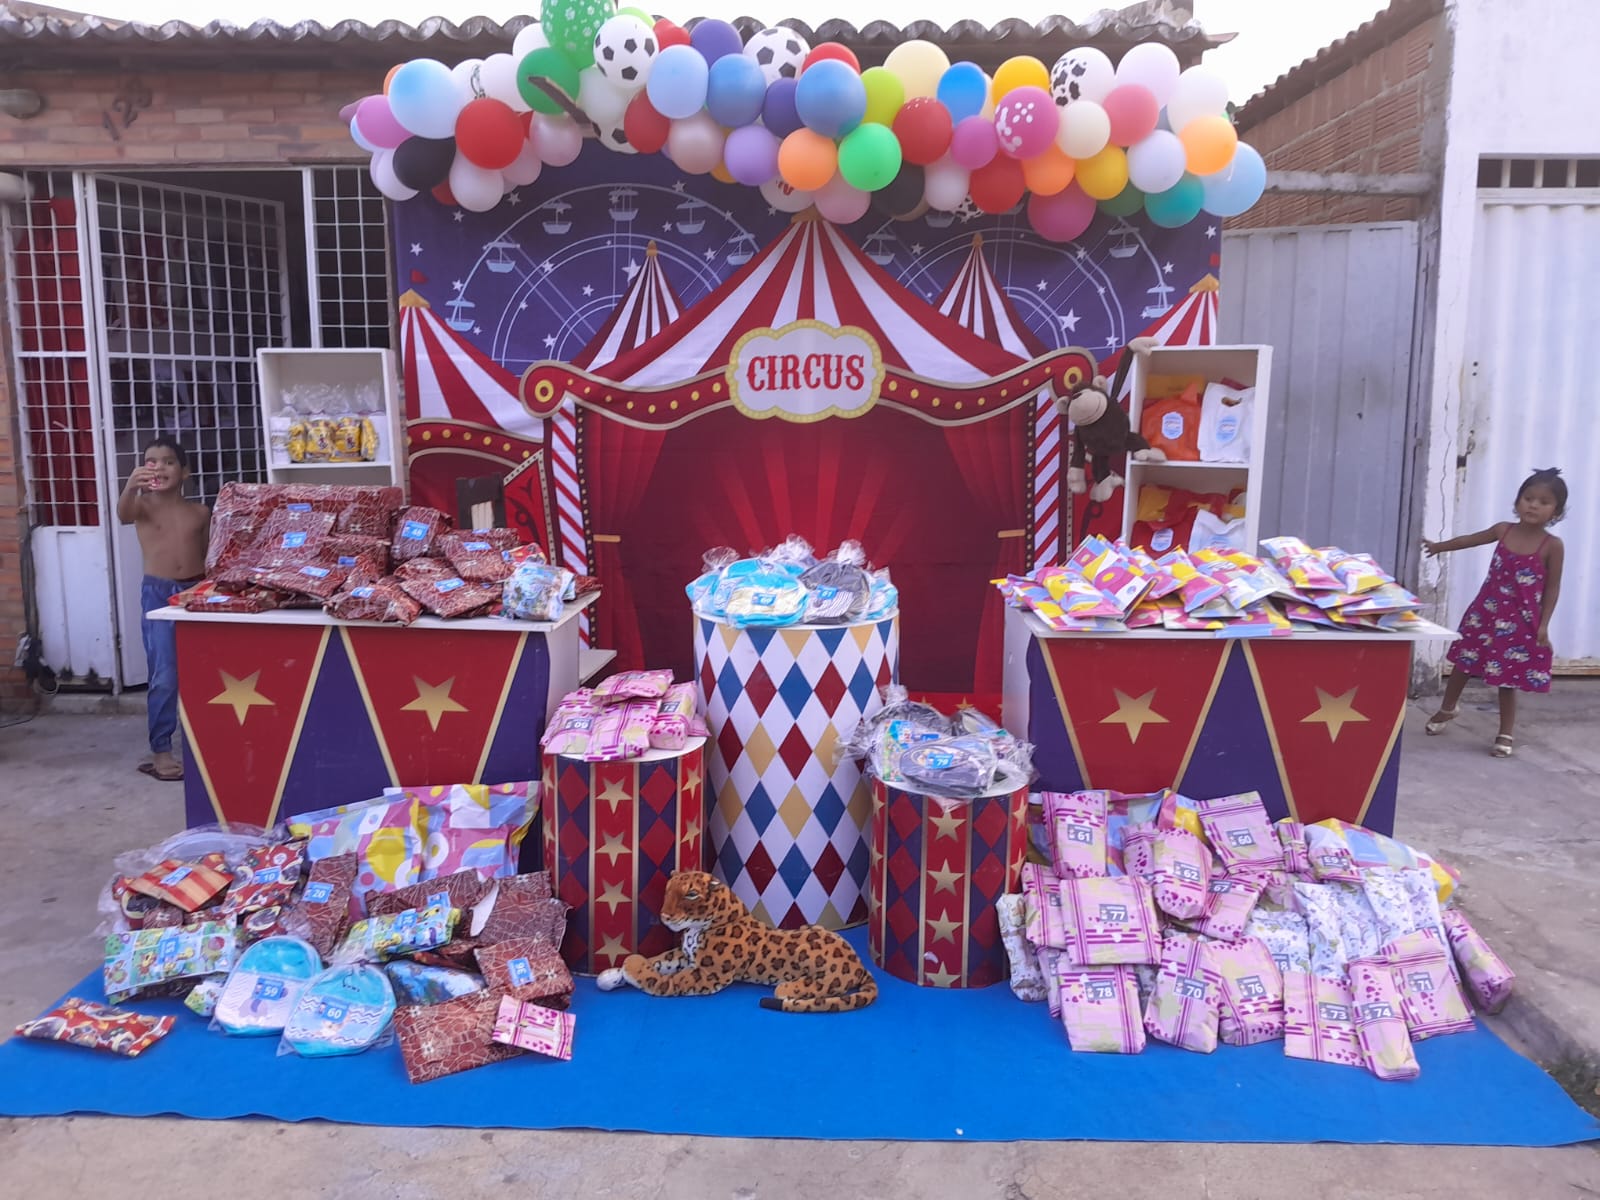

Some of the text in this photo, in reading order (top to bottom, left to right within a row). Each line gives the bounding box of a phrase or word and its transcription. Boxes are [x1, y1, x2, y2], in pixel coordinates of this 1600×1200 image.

[747, 353, 865, 392] CIRCUS
[1077, 831, 1090, 842] 61
[1238, 834, 1252, 844] 60
[264, 873, 275, 881] 10
[1183, 869, 1199, 881] 62
[312, 889, 326, 898] 20
[1213, 884, 1229, 892] 67
[1109, 911, 1126, 921] 77
[1247, 983, 1264, 994] 76
[1417, 979, 1431, 991] 71
[264, 986, 278, 997] 59
[1095, 986, 1113, 997] 78
[1186, 985, 1202, 998] 70
[326, 1007, 342, 1019] 60
[1330, 1010, 1347, 1020] 73
[1375, 1008, 1391, 1018] 74
